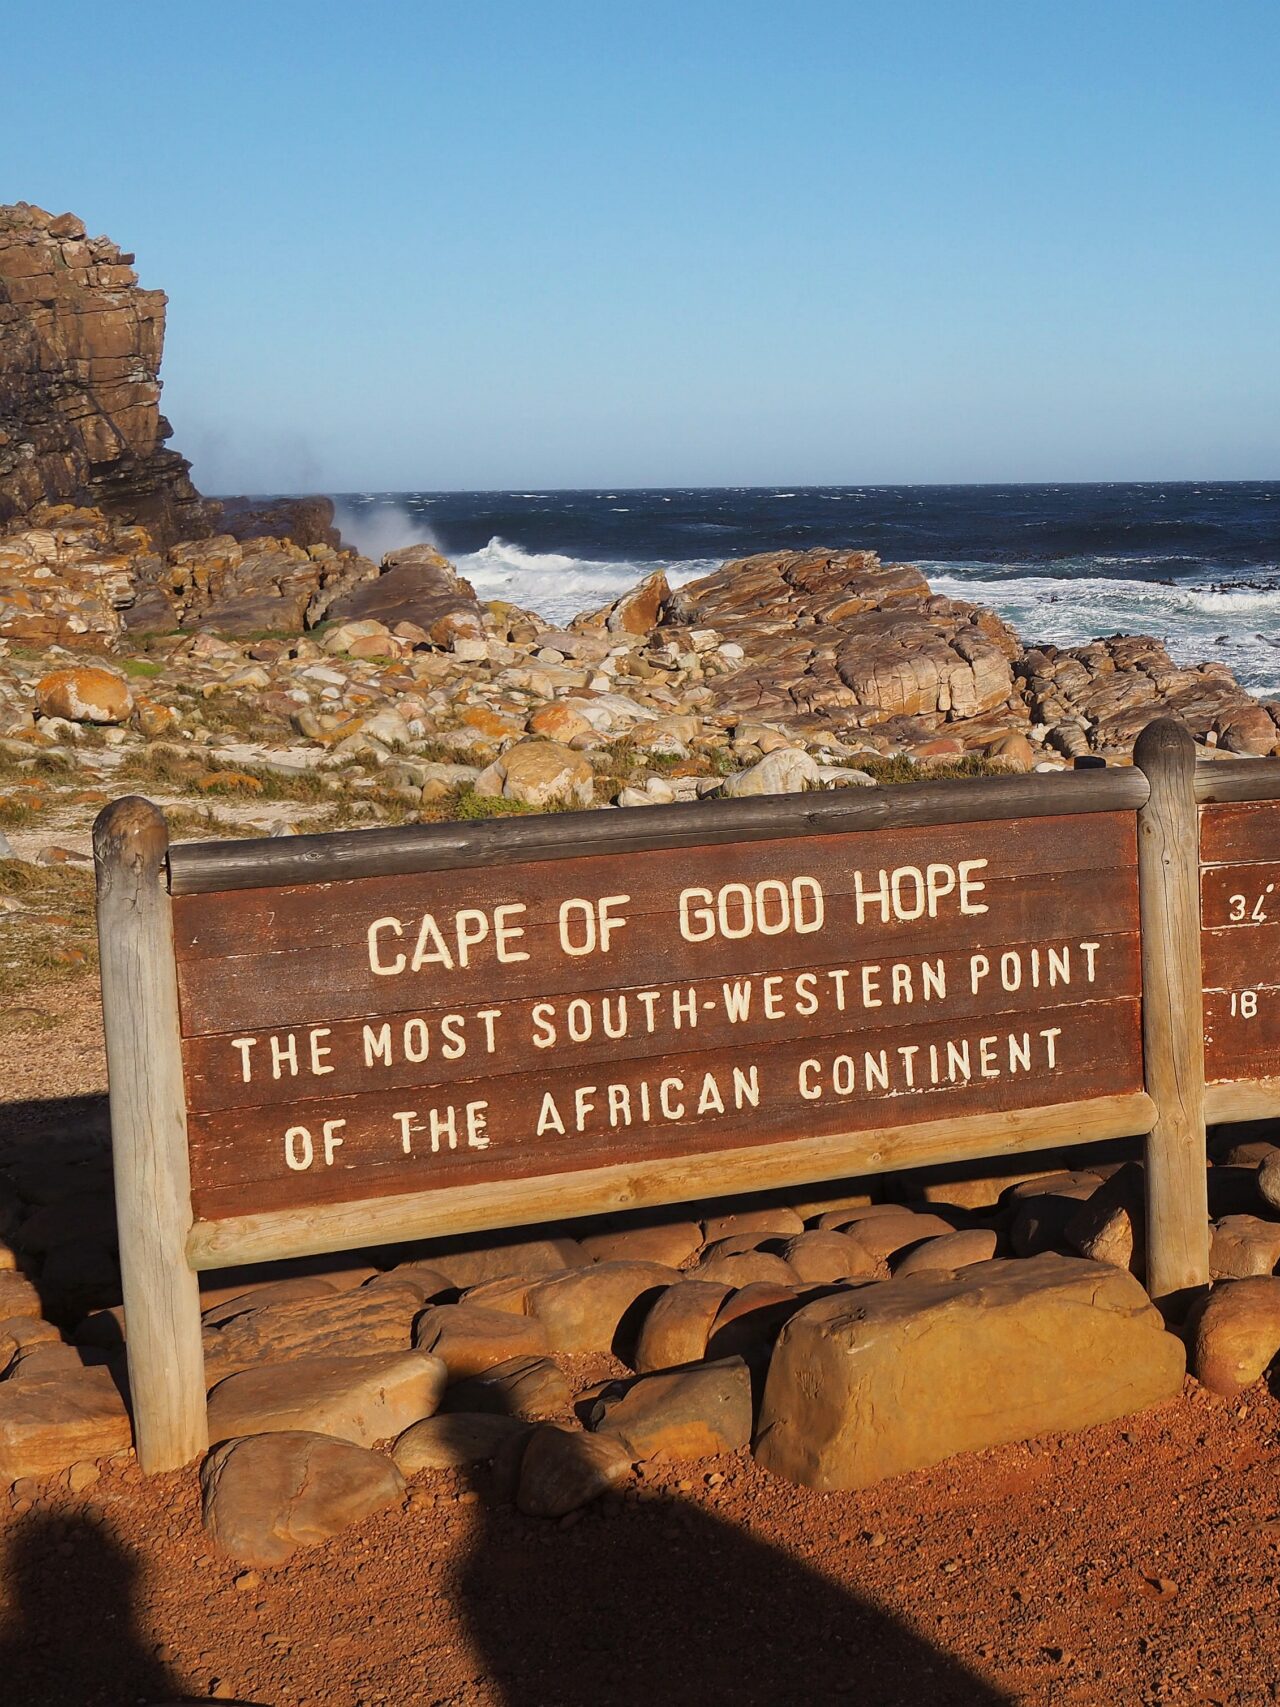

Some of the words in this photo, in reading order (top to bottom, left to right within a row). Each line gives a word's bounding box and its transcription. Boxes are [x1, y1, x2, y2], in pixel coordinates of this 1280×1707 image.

[367, 902, 531, 975] CAPE
[560, 894, 630, 958] OF
[678, 875, 825, 943] GOOD
[855, 858, 989, 925] HOPE
[231, 1027, 335, 1083] THE
[363, 1010, 502, 1069] MOST
[532, 958, 947, 1048] SOUTH-WESTERN
[970, 943, 1100, 992] POINT
[283, 1119, 346, 1171] OF
[399, 1100, 490, 1154] THE
[537, 1066, 760, 1136] AFRICAN
[799, 1028, 1063, 1099] CONTINENT
